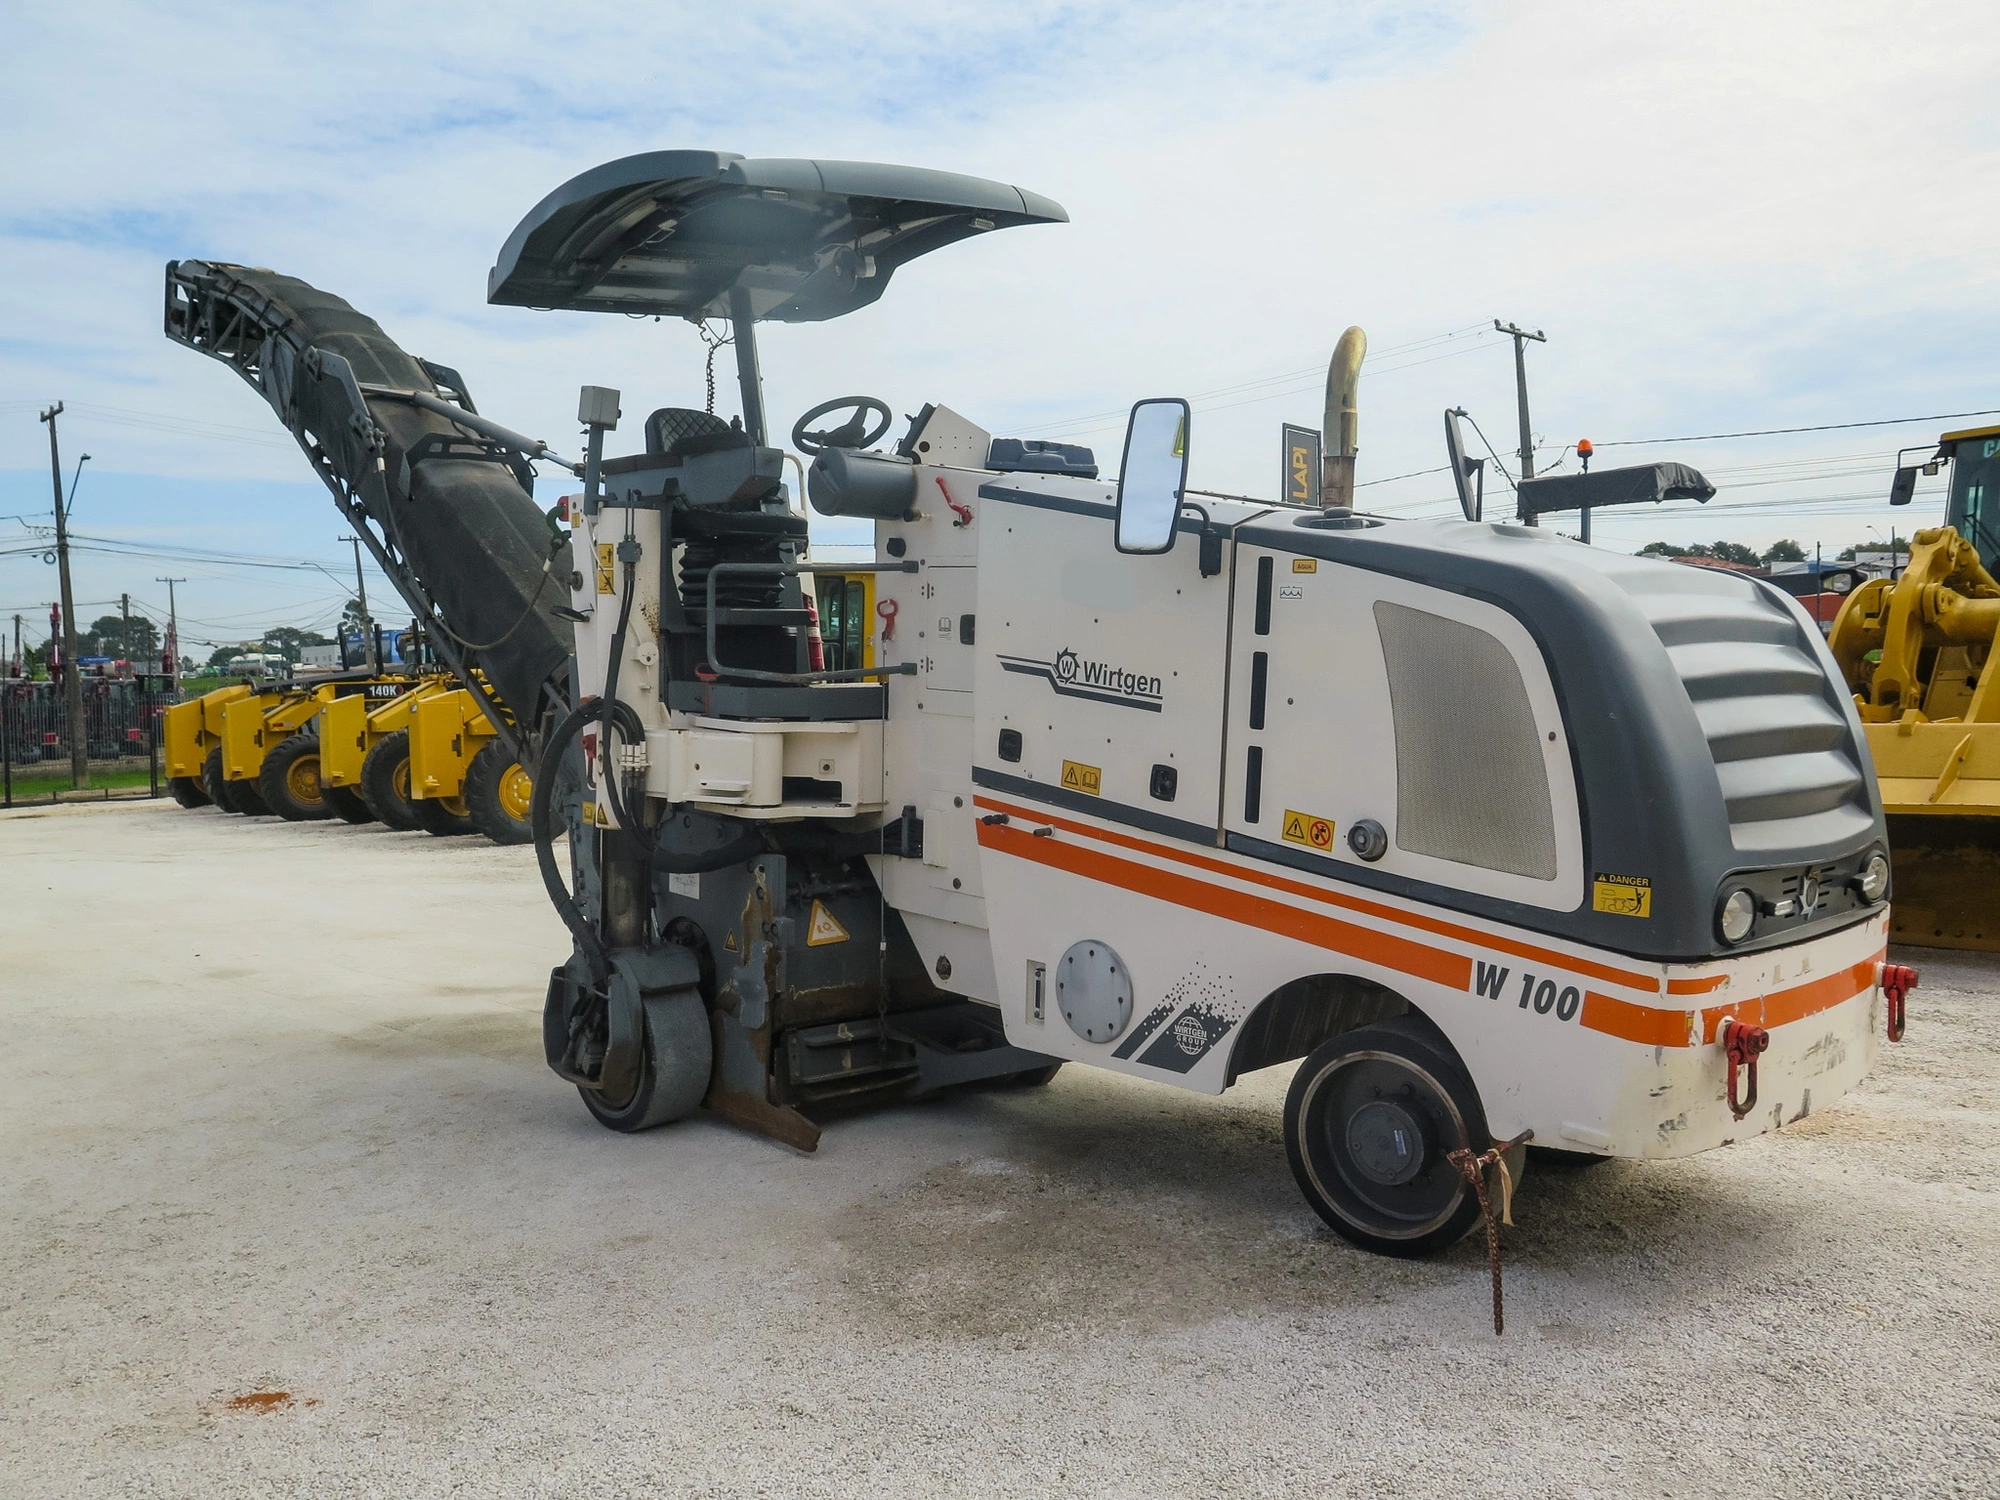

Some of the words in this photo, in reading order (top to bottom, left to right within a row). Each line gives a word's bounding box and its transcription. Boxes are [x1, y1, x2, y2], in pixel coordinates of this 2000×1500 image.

[1293, 446, 1308, 499] LAPI
[1083, 660, 1162, 695] Wirtgen
[369, 684, 397, 697] 140K
[1609, 874, 1649, 887] DANGER
[1476, 960, 1510, 1001] W
[1518, 973, 1580, 1022] 100
[1174, 1024, 1207, 1038] WIRTGEN
[1176, 1035, 1205, 1046] GROUP
